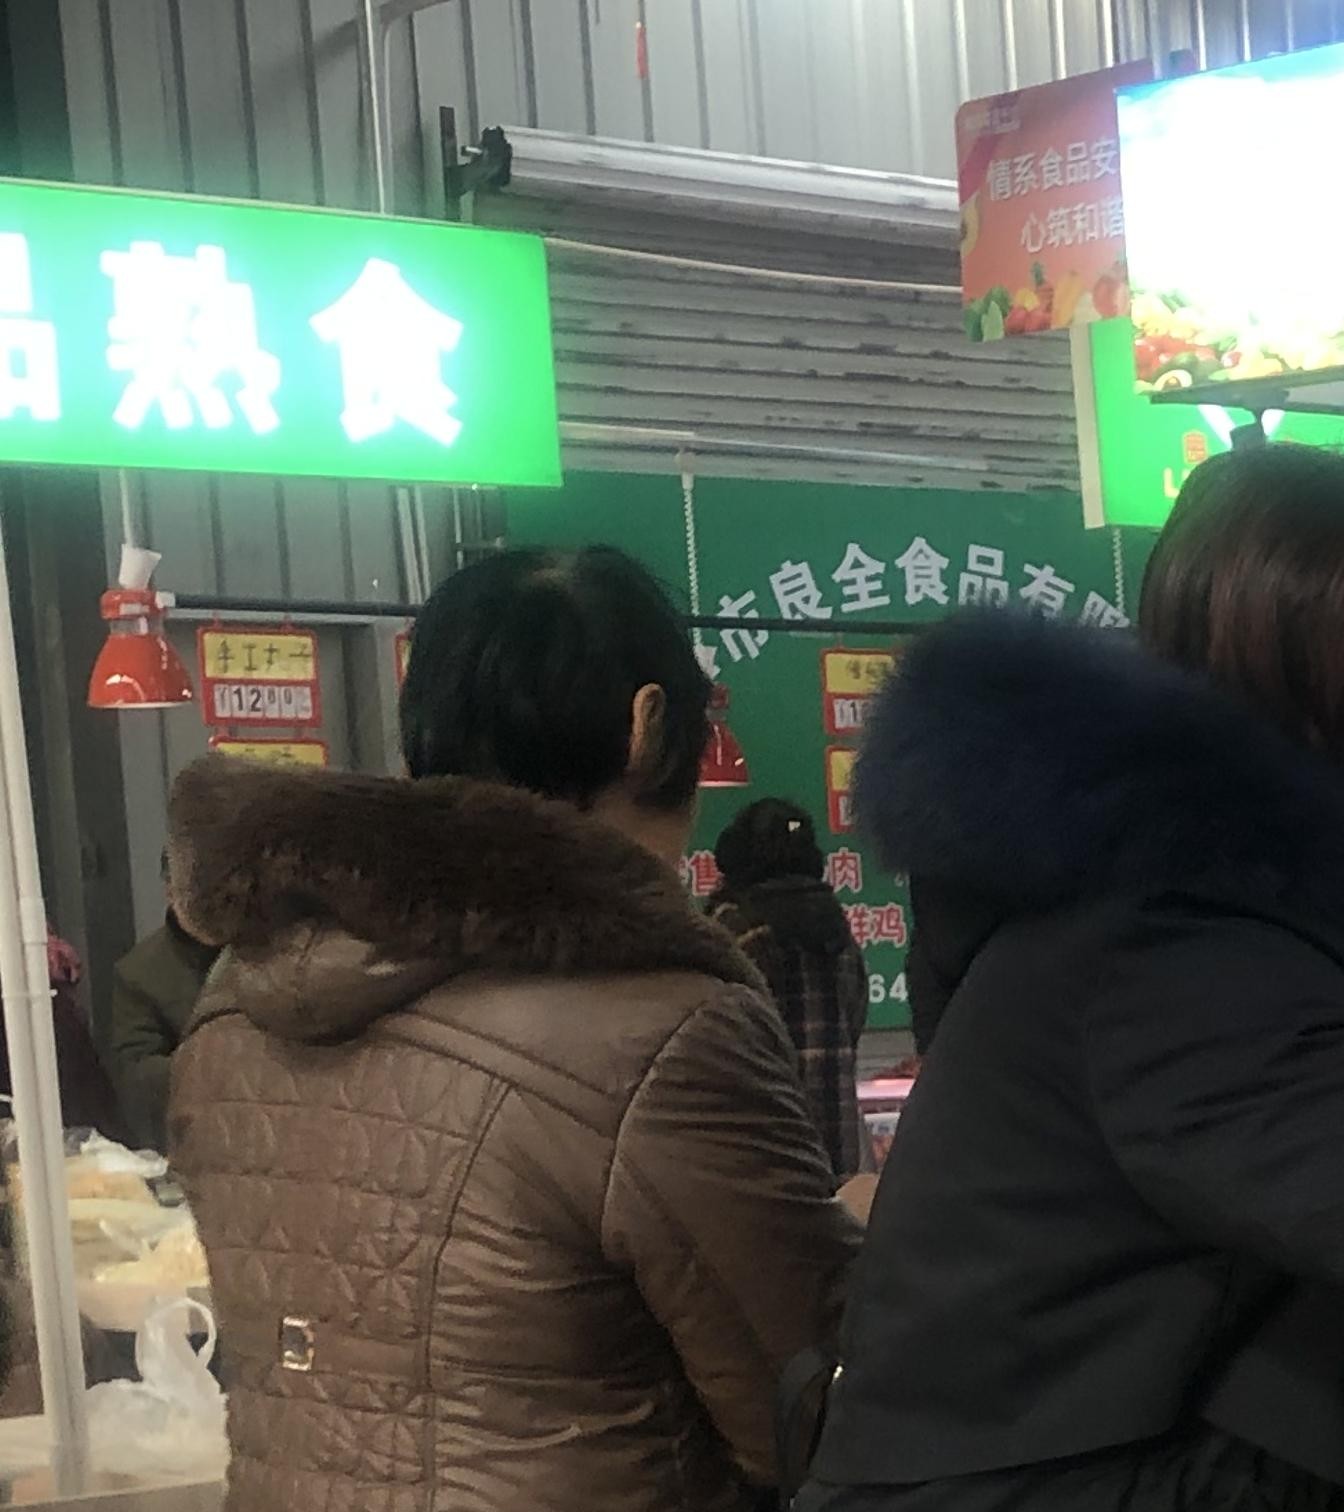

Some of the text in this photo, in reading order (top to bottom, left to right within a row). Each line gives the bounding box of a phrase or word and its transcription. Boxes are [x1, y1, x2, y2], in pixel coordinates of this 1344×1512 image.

[986, 138, 1118, 202] 情系食品安
